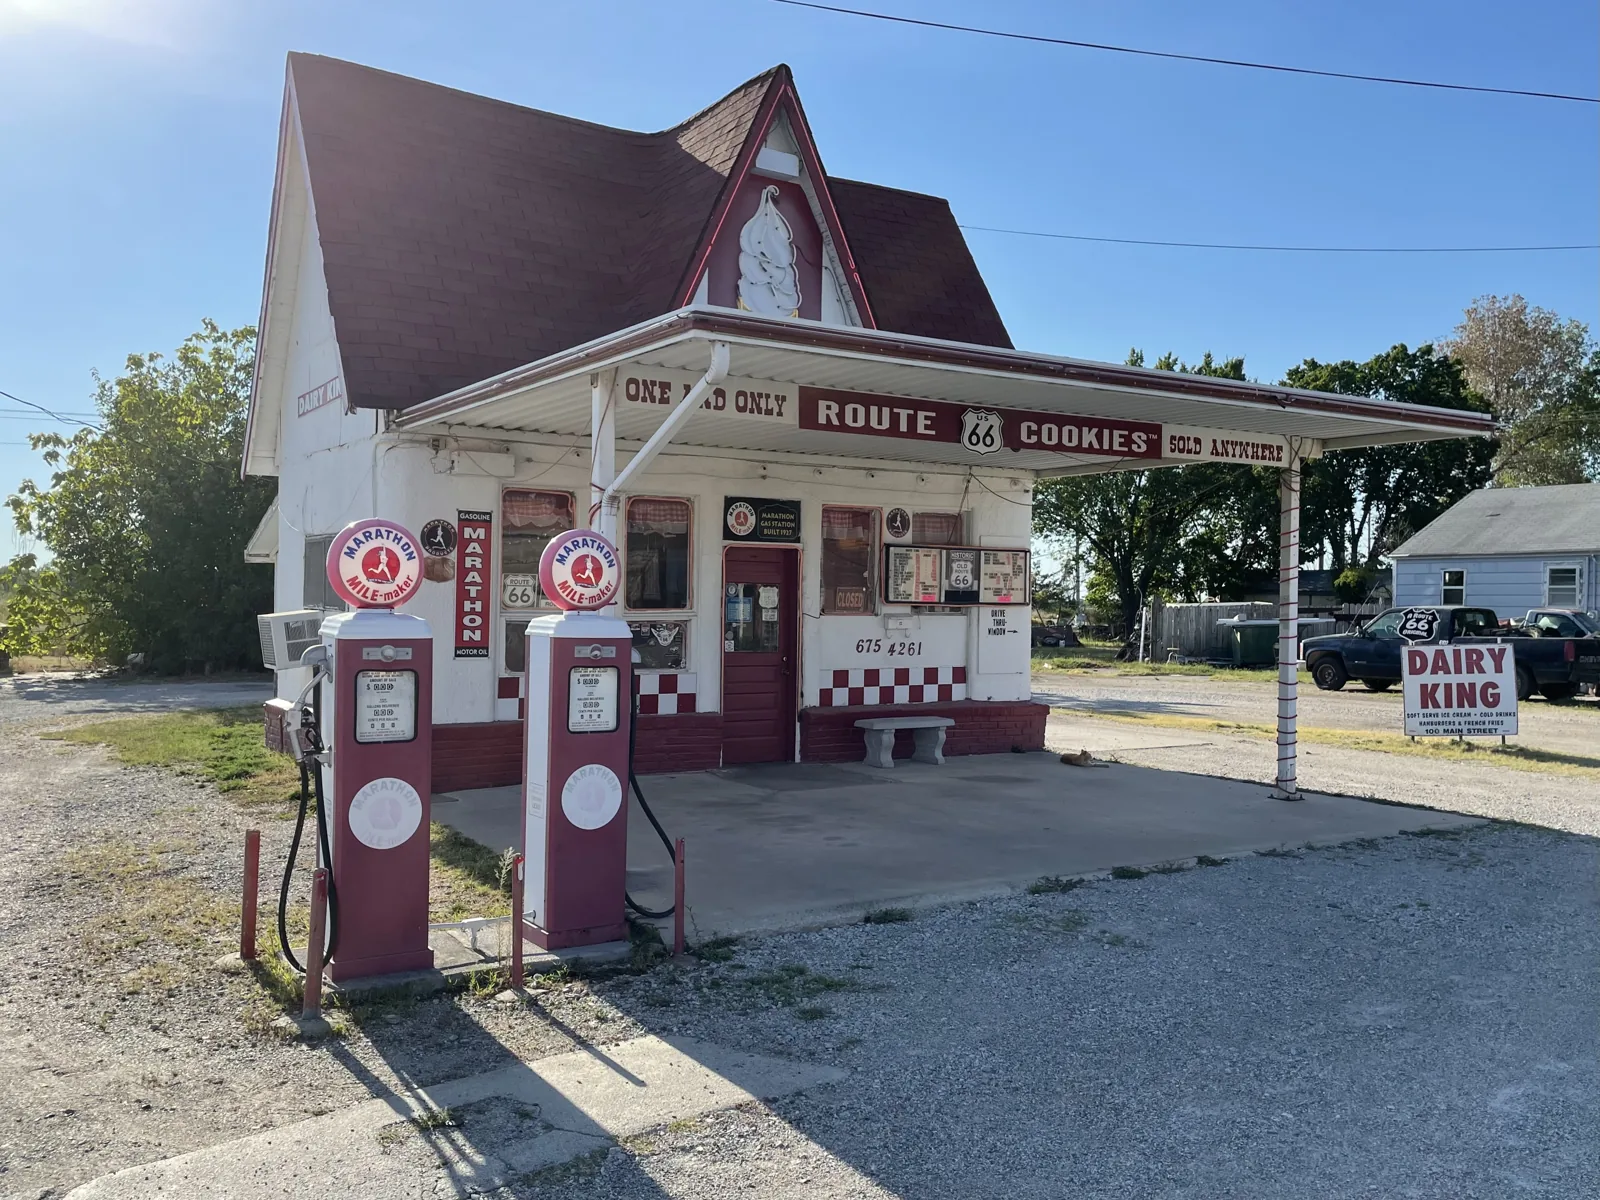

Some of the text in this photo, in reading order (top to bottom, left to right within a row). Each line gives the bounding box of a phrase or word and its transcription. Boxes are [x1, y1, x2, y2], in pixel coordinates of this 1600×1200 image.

[299, 385, 325, 415] DAIRY
[625, 377, 672, 405] ONE
[735, 390, 787, 417] ONLY
[818, 399, 937, 435] ROUTE
[976, 414, 989, 422] US
[967, 422, 995, 448] 66
[1020, 421, 1148, 453] COOKIES
[1169, 434, 1284, 462] SOLD ANYWHERE
[459, 512, 491, 521] GASOLINE
[729, 503, 755, 517] MARATHON
[761, 512, 795, 520] MARATHON
[763, 528, 780, 536] BUILT
[343, 528, 417, 562] MARATHON
[555, 537, 616, 569] MARATHON
[346, 575, 414, 602] MILE-maker
[462, 526, 486, 642] MARATHON
[557, 580, 614, 604] MILE-maker
[954, 574, 969, 586] 66
[508, 587, 531, 603] 66
[837, 592, 864, 608] CLOSED
[990, 609, 1006, 618] DRIVE
[1405, 618, 1429, 631] 66
[1413, 613, 1434, 621] ROUTE
[987, 628, 1007, 636] WINDOW
[1402, 629, 1428, 638] ORIGINAL
[855, 638, 922, 657] 675 4261
[1407, 648, 1507, 676] DAIRY
[1420, 681, 1501, 710] KING
[565, 766, 620, 794] MARATHON
[352, 780, 419, 811] MARATHON
